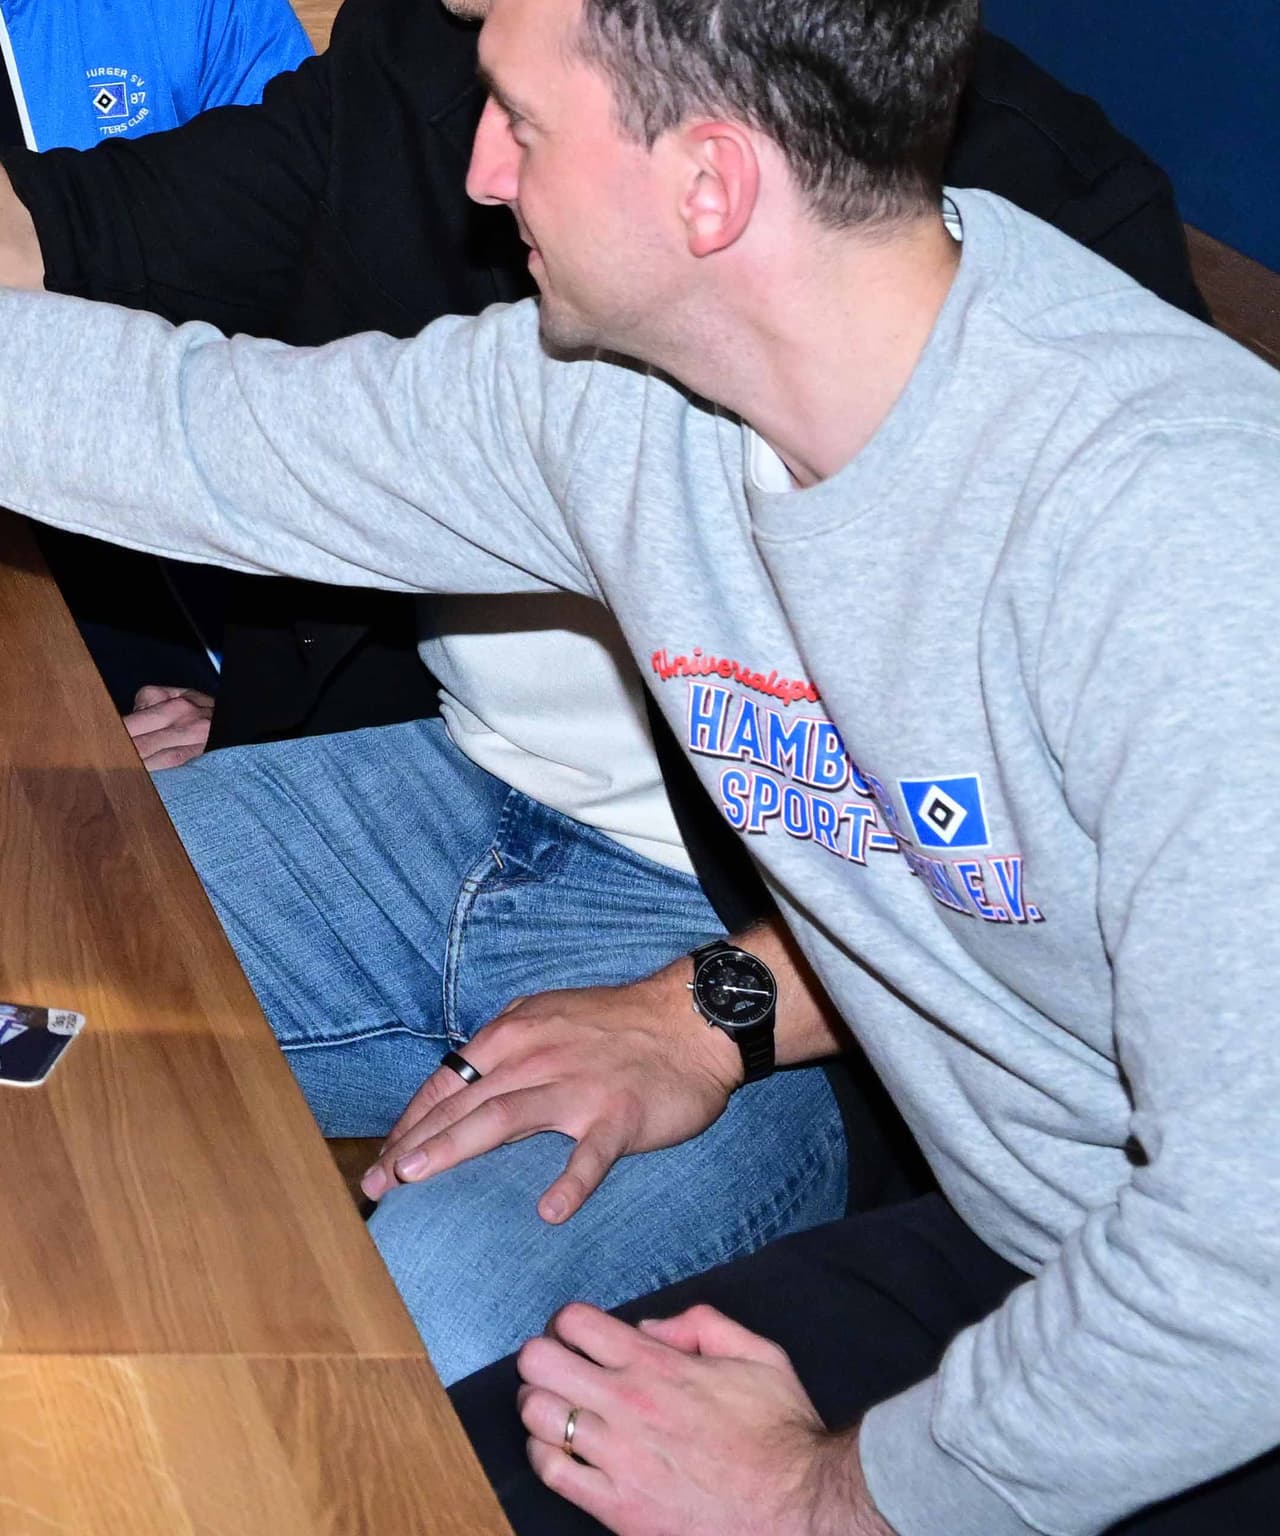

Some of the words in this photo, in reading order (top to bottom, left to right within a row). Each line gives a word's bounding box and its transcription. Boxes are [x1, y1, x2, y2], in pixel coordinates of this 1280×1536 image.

[130, 74, 145, 87] SV
[130, 91, 147, 105] 87
[100, 124, 127, 135] TERS
[127, 107, 149, 127] CLUB
[952, 857, 1045, 925] E.V.
